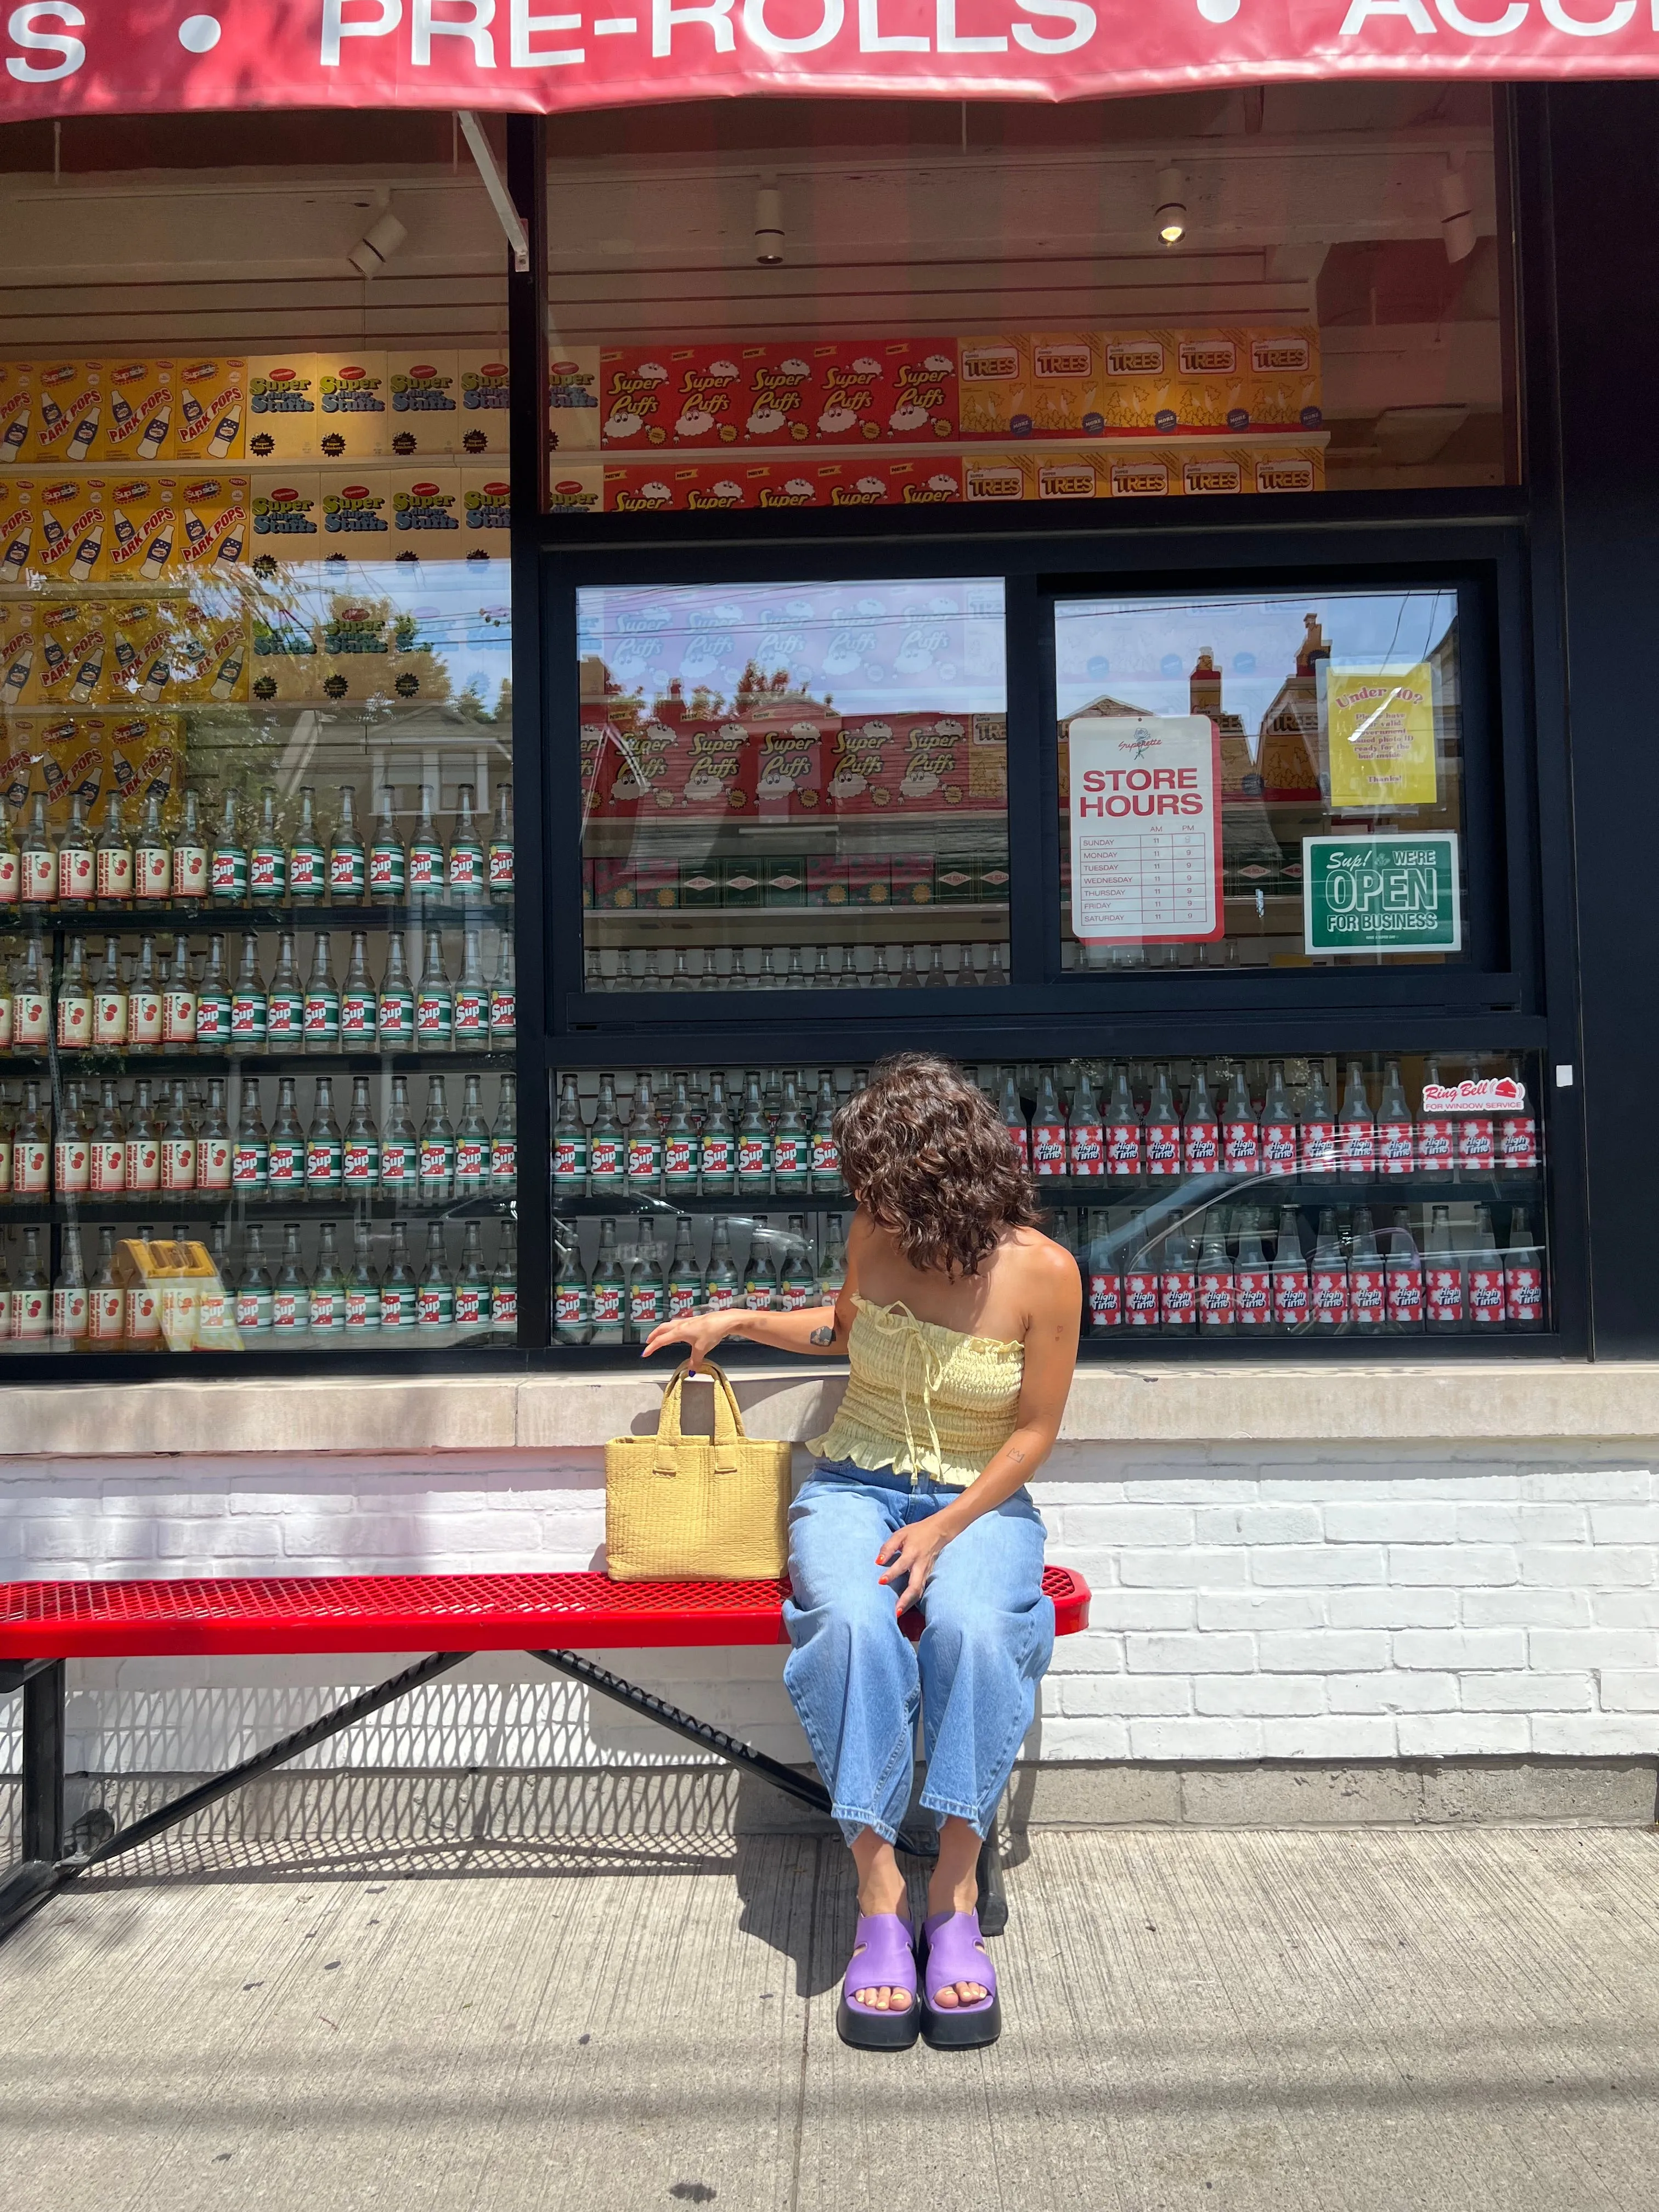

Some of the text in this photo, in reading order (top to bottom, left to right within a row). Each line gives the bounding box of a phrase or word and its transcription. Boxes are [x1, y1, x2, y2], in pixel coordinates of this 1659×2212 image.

[320, 0, 1098, 69] PRE-ROLLS
[1038, 355, 1089, 374] TREES
[1110, 351, 1160, 371] TREES
[319, 376, 382, 394] Super
[608, 371, 662, 394] Super
[679, 371, 733, 392] Super
[752, 369, 804, 391] Super
[823, 367, 876, 390] Super
[894, 365, 947, 387] Super
[249, 377, 311, 395] Super
[251, 395, 314, 413] Stuffs
[321, 394, 385, 413] Stuffs
[610, 394, 658, 416] Puffs
[681, 393, 730, 414] Puffs
[753, 391, 801, 411] Puffs
[825, 390, 872, 411] Puffs
[896, 388, 945, 409] Puffs
[1042, 476, 1093, 498] TREES
[1115, 474, 1166, 495] TREES
[42, 508, 103, 563] PARK POPS
[112, 507, 173, 562] PARK POPS
[183, 506, 244, 561] PARK POPS
[1336, 687, 1387, 708] Under
[761, 731, 816, 754] Super
[833, 728, 887, 753] Super
[905, 727, 959, 751] Super
[1119, 738, 1163, 751] Superette
[762, 755, 811, 777] Puffs
[836, 754, 883, 776] Puffs
[906, 752, 956, 773] Puffs
[1083, 768, 1198, 792] STORE
[1080, 793, 1203, 817] HOURS
[251, 862, 274, 878] Sup
[291, 861, 313, 879] Sup
[331, 861, 353, 879] Sup
[371, 860, 391, 879] Sup
[410, 859, 432, 878] Sup
[450, 860, 473, 878] Sup
[490, 858, 513, 878] Sup
[1327, 850, 1372, 871] Sup!
[1325, 868, 1438, 913] OPEN
[1327, 912, 1438, 932] FOR BUSINESS
[269, 1007, 291, 1026] Sup
[342, 1006, 365, 1025] Sup
[418, 1005, 441, 1025] Sup
[456, 1005, 479, 1023] Sup
[492, 1003, 514, 1022] Sup
[1425, 1082, 1488, 1101] Ring Bell
[1040, 1142, 1059, 1153] High
[1116, 1141, 1136, 1152] High
[1193, 1140, 1212, 1151] High
[1234, 1139, 1254, 1150] High
[1425, 1146, 1448, 1155] Time
[1426, 1137, 1447, 1147] High
[1464, 1145, 1488, 1154] Time
[1466, 1136, 1487, 1147] High
[458, 1152, 481, 1171] Sup
[592, 1150, 616, 1169] Sup
[629, 1153, 653, 1172] Sup
[666, 1150, 690, 1169] Sup
[703, 1149, 728, 1168] Sup
[740, 1149, 763, 1169] Sup
[775, 1148, 797, 1167] Sup
[1037, 1151, 1061, 1161] Time
[1114, 1150, 1137, 1160] Time
[1191, 1149, 1214, 1159] Time
[1232, 1148, 1255, 1158] Time
[308, 1154, 331, 1173] Sup
[421, 1154, 445, 1172] Sup
[1095, 1292, 1115, 1302] High
[1170, 1291, 1189, 1301] High
[1284, 1291, 1304, 1300] High
[1318, 1298, 1342, 1307] Time
[1321, 1290, 1341, 1299] High
[1475, 1297, 1499, 1306] Time
[1477, 1289, 1497, 1298] High
[455, 1300, 479, 1320] Sup
[556, 1299, 580, 1316] Sup
[595, 1299, 619, 1317] Sup
[1093, 1300, 1116, 1310] Time
[1167, 1299, 1190, 1309] Time
[1282, 1299, 1306, 1308] Time
